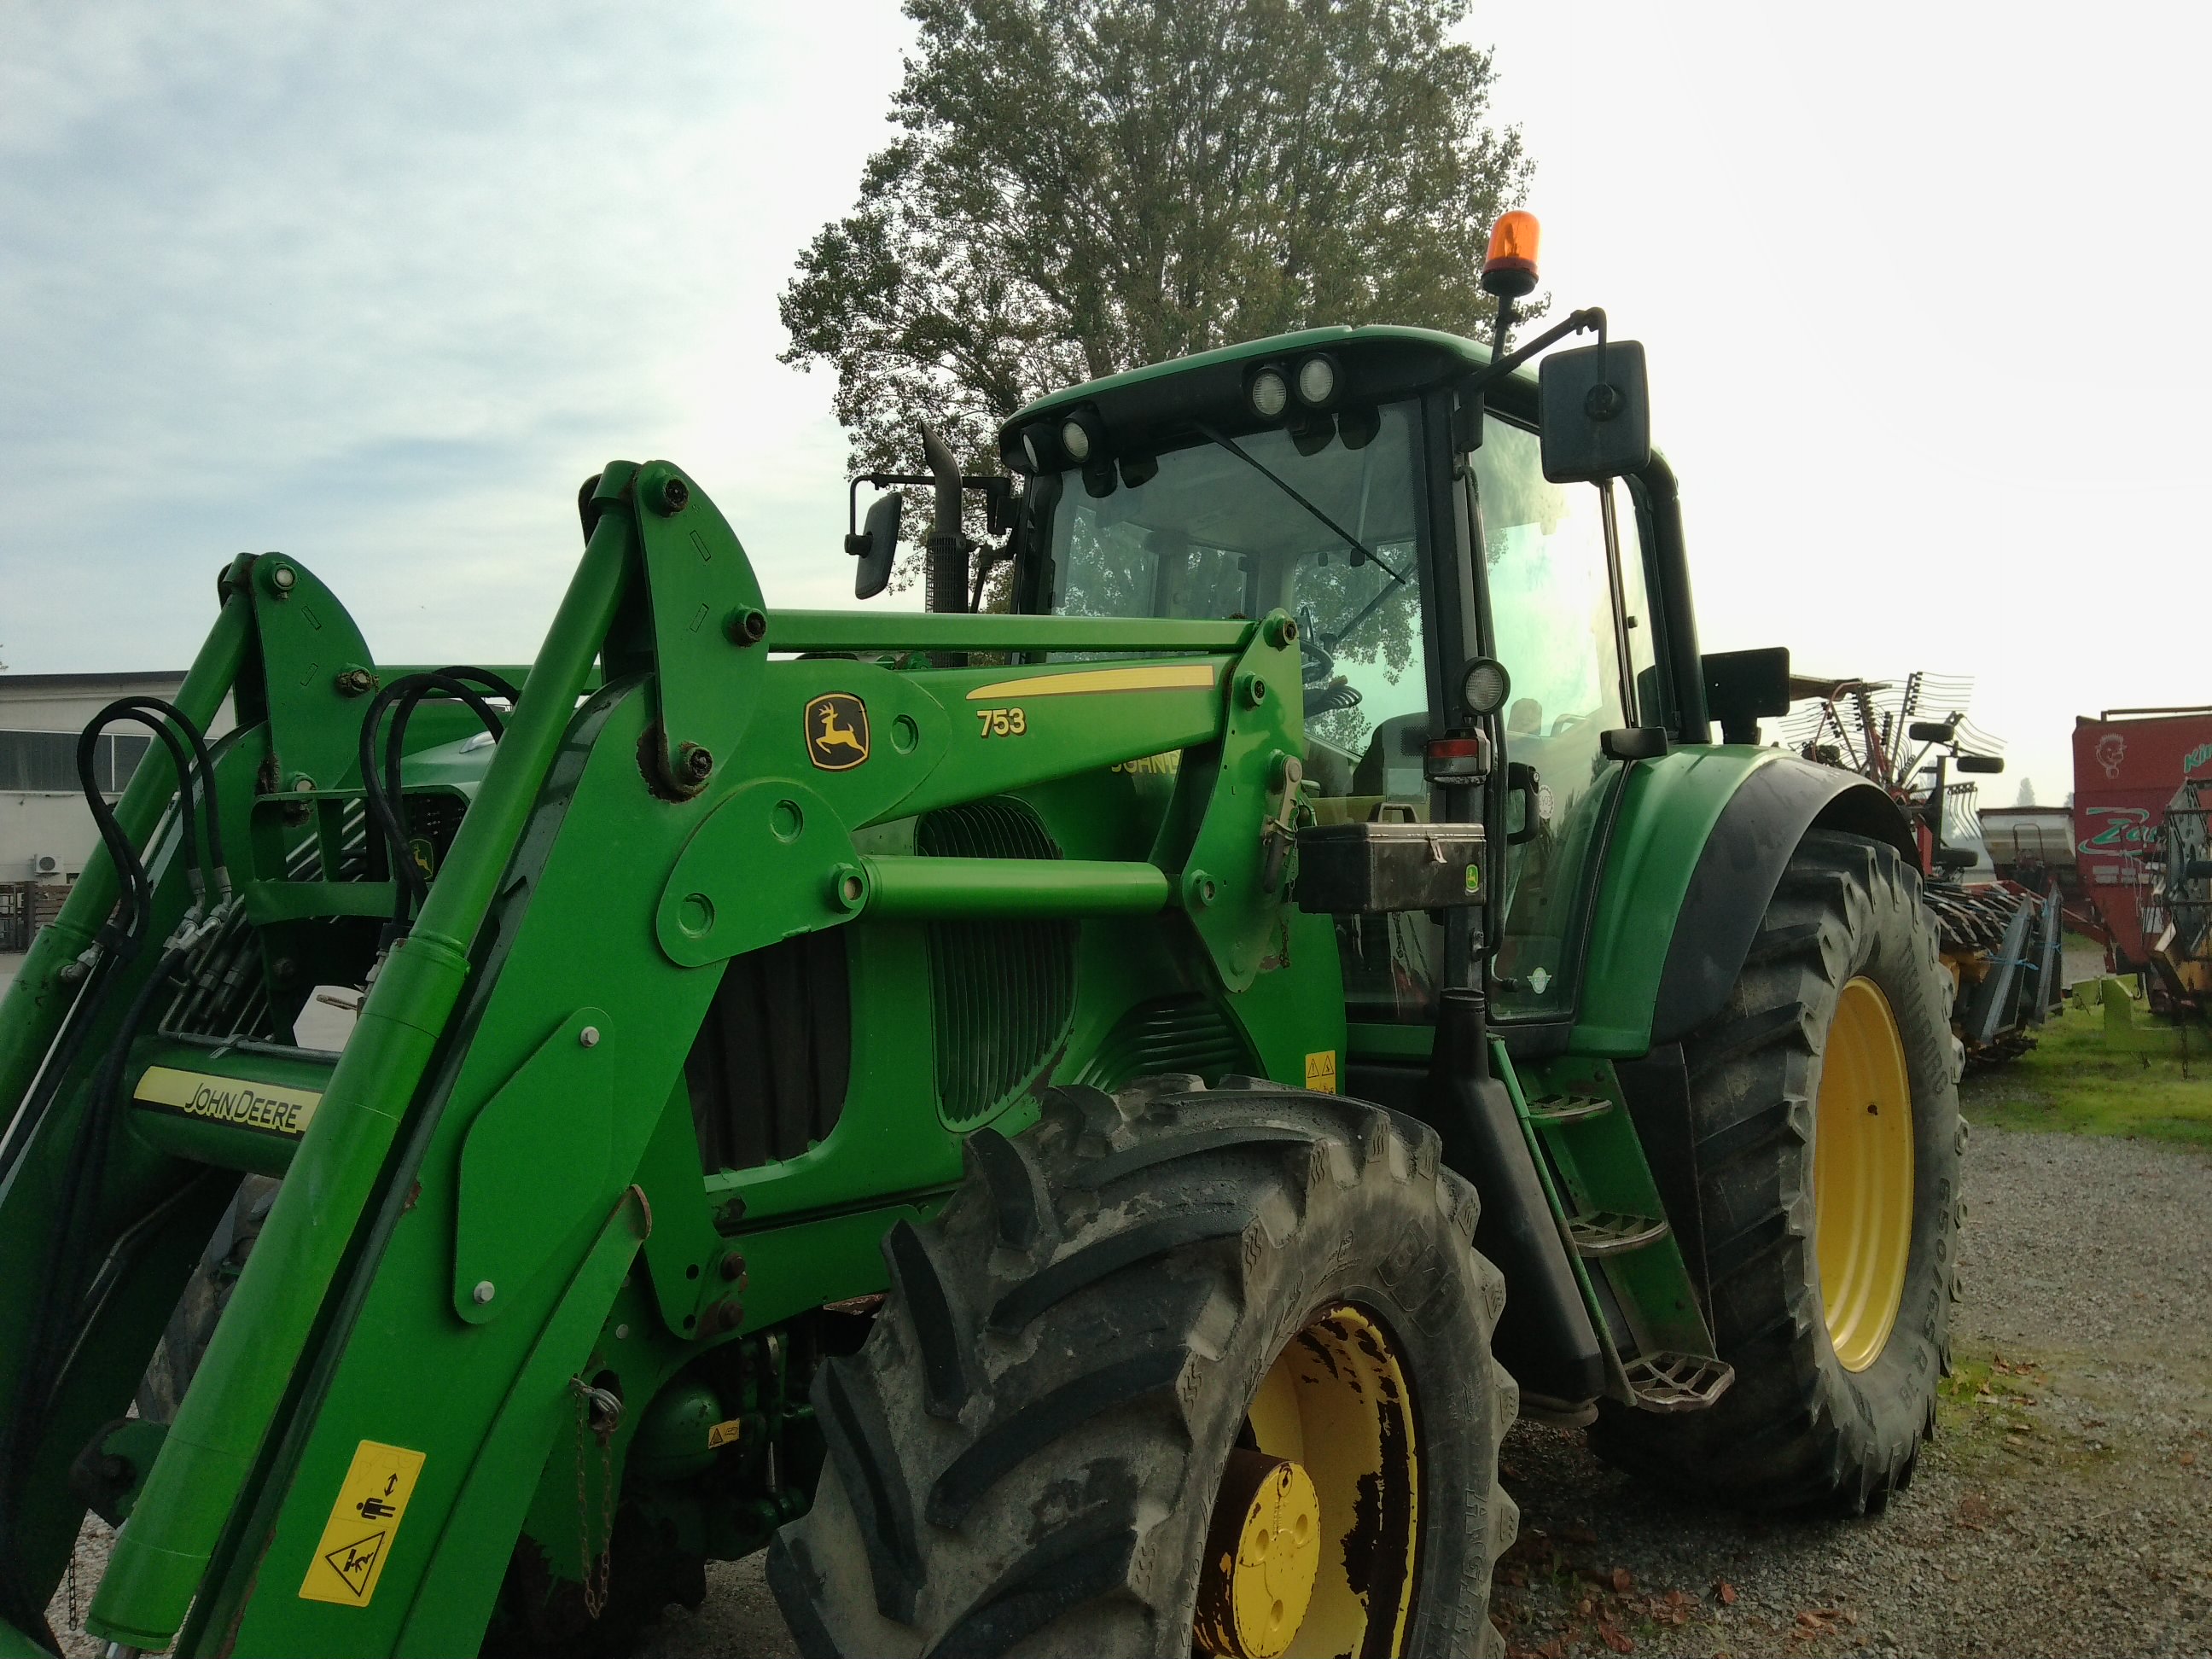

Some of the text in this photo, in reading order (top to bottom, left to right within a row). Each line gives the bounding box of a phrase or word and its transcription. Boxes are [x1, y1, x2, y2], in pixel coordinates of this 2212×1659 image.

[977, 707, 1027, 738] 753
[184, 1082, 303, 1132] JOHN DEERE
[1924, 1177, 1951, 1346] 650/65
